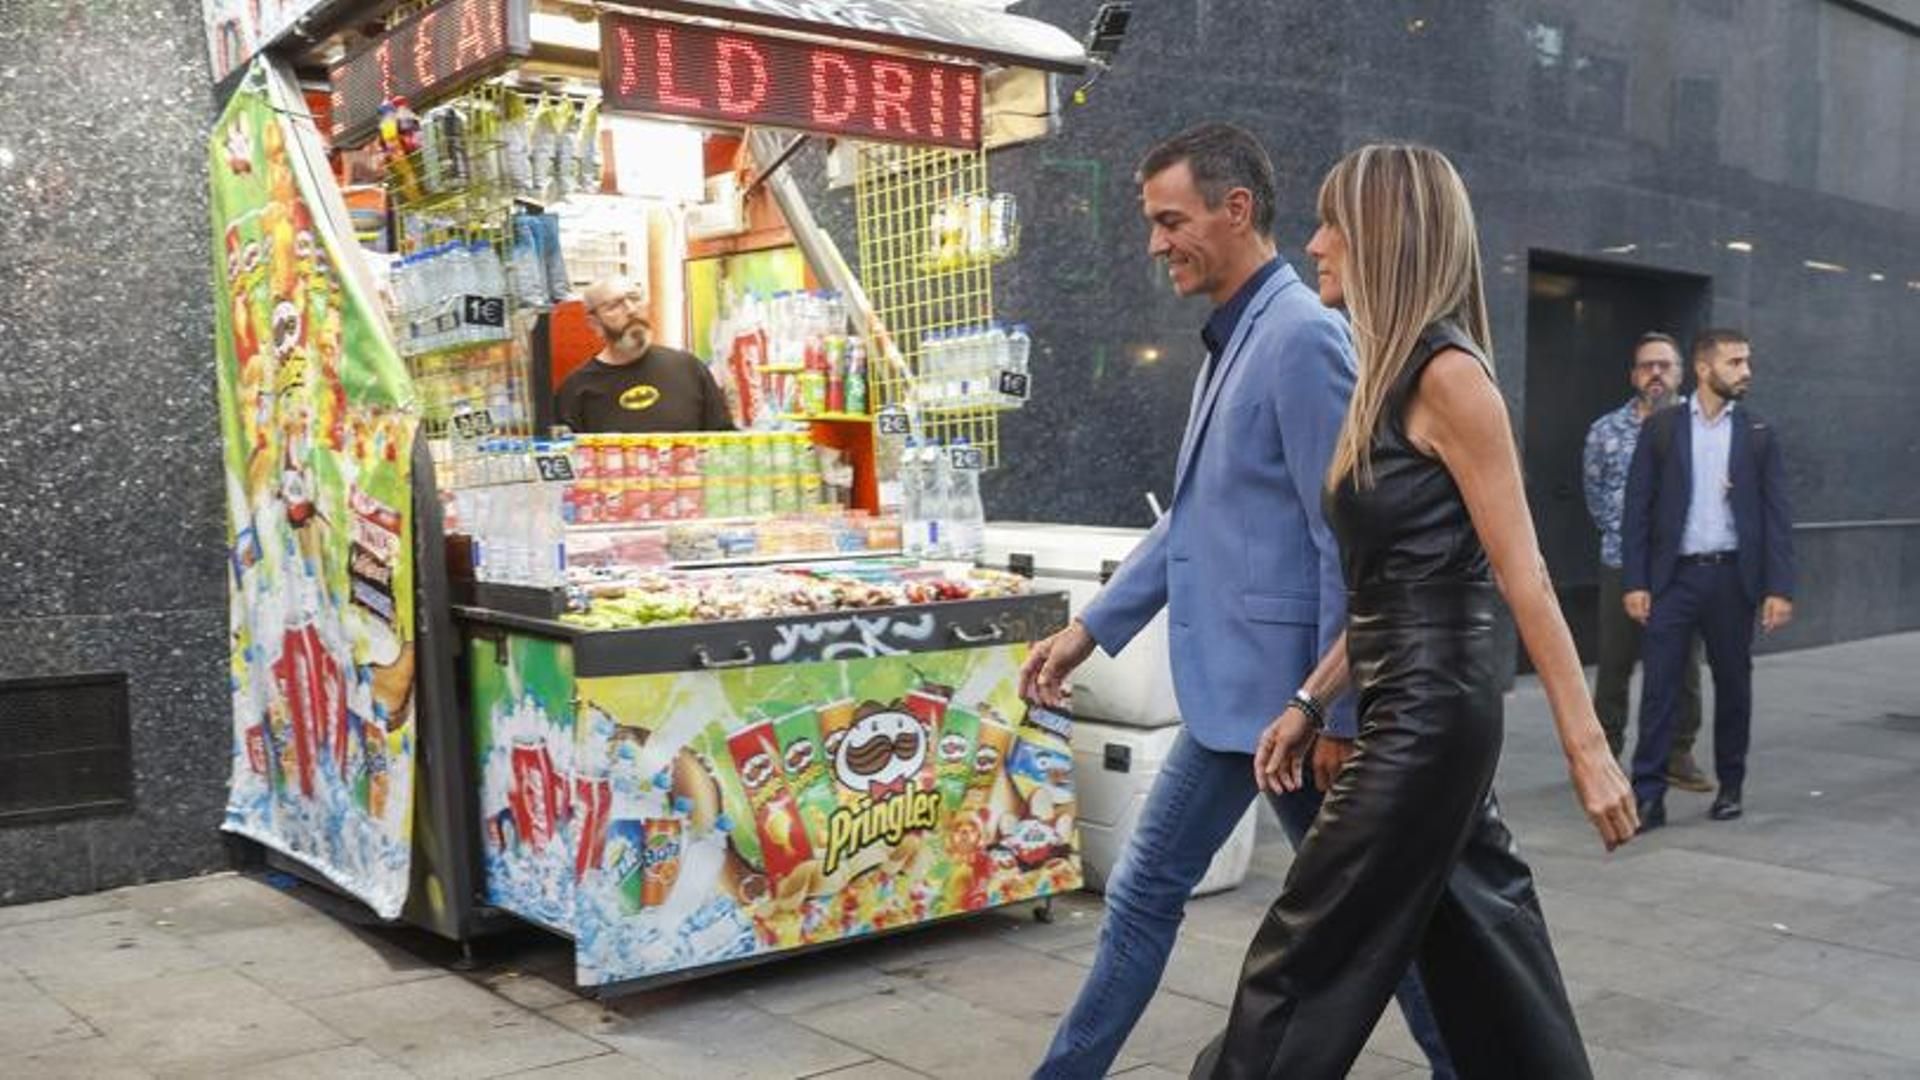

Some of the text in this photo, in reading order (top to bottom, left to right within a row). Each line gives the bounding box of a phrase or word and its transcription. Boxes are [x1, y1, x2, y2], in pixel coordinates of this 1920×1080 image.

[811, 51, 977, 141] DRI
[471, 300, 500, 323] 1€
[823, 779, 942, 877] Pringles
